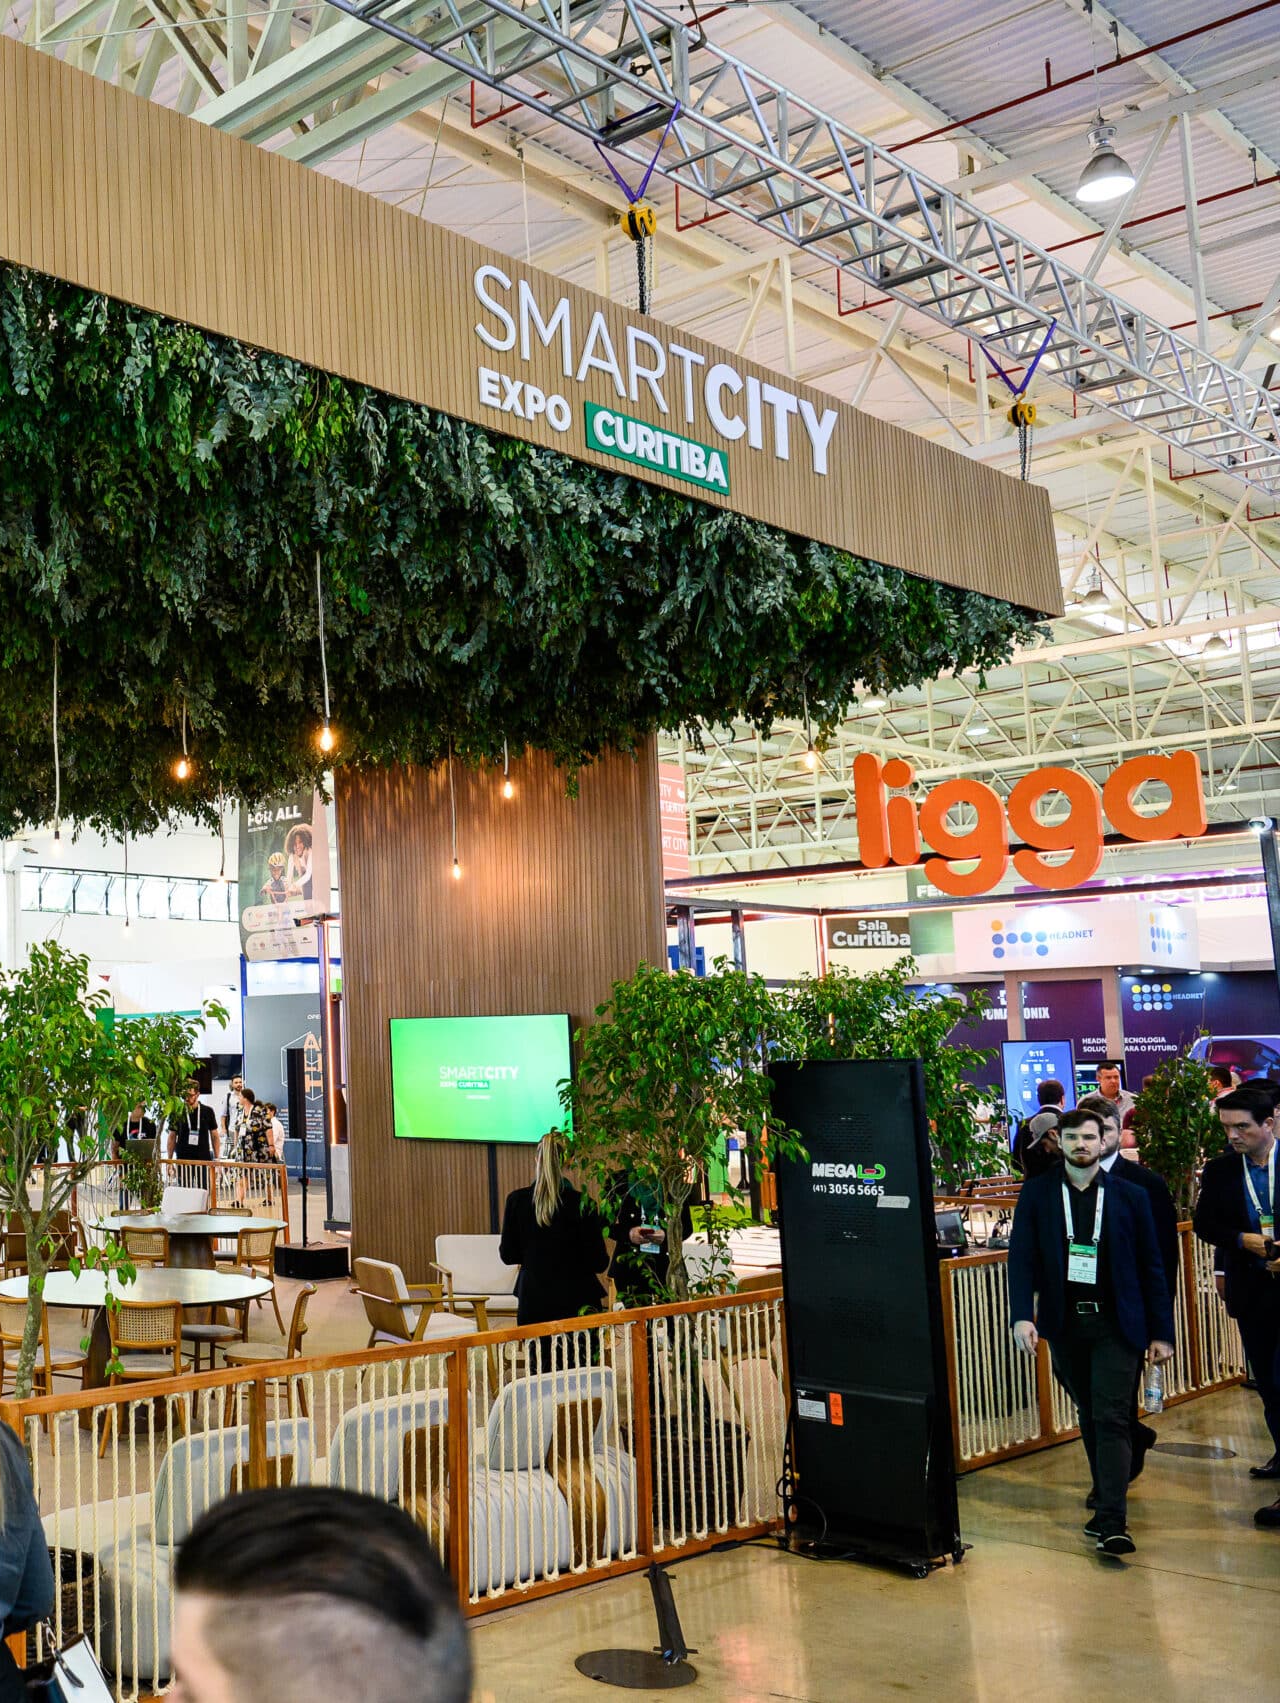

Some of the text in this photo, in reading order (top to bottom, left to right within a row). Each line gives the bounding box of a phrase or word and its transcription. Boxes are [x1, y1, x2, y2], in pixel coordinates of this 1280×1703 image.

[477, 366, 572, 433] EXPO
[592, 409, 728, 488] CURITIBA
[275, 804, 303, 823] ALL
[852, 749, 1208, 897] ligga
[857, 919, 888, 931] Sala
[832, 930, 911, 947] Curitiba
[1049, 928, 1094, 940] HEADNET
[1172, 991, 1204, 1000] HEADNET
[1124, 1036, 1166, 1044] ECNOLOGIA
[1147, 1044, 1178, 1052] FUTURO
[812, 1183, 885, 1196] (41) 3056 5665
